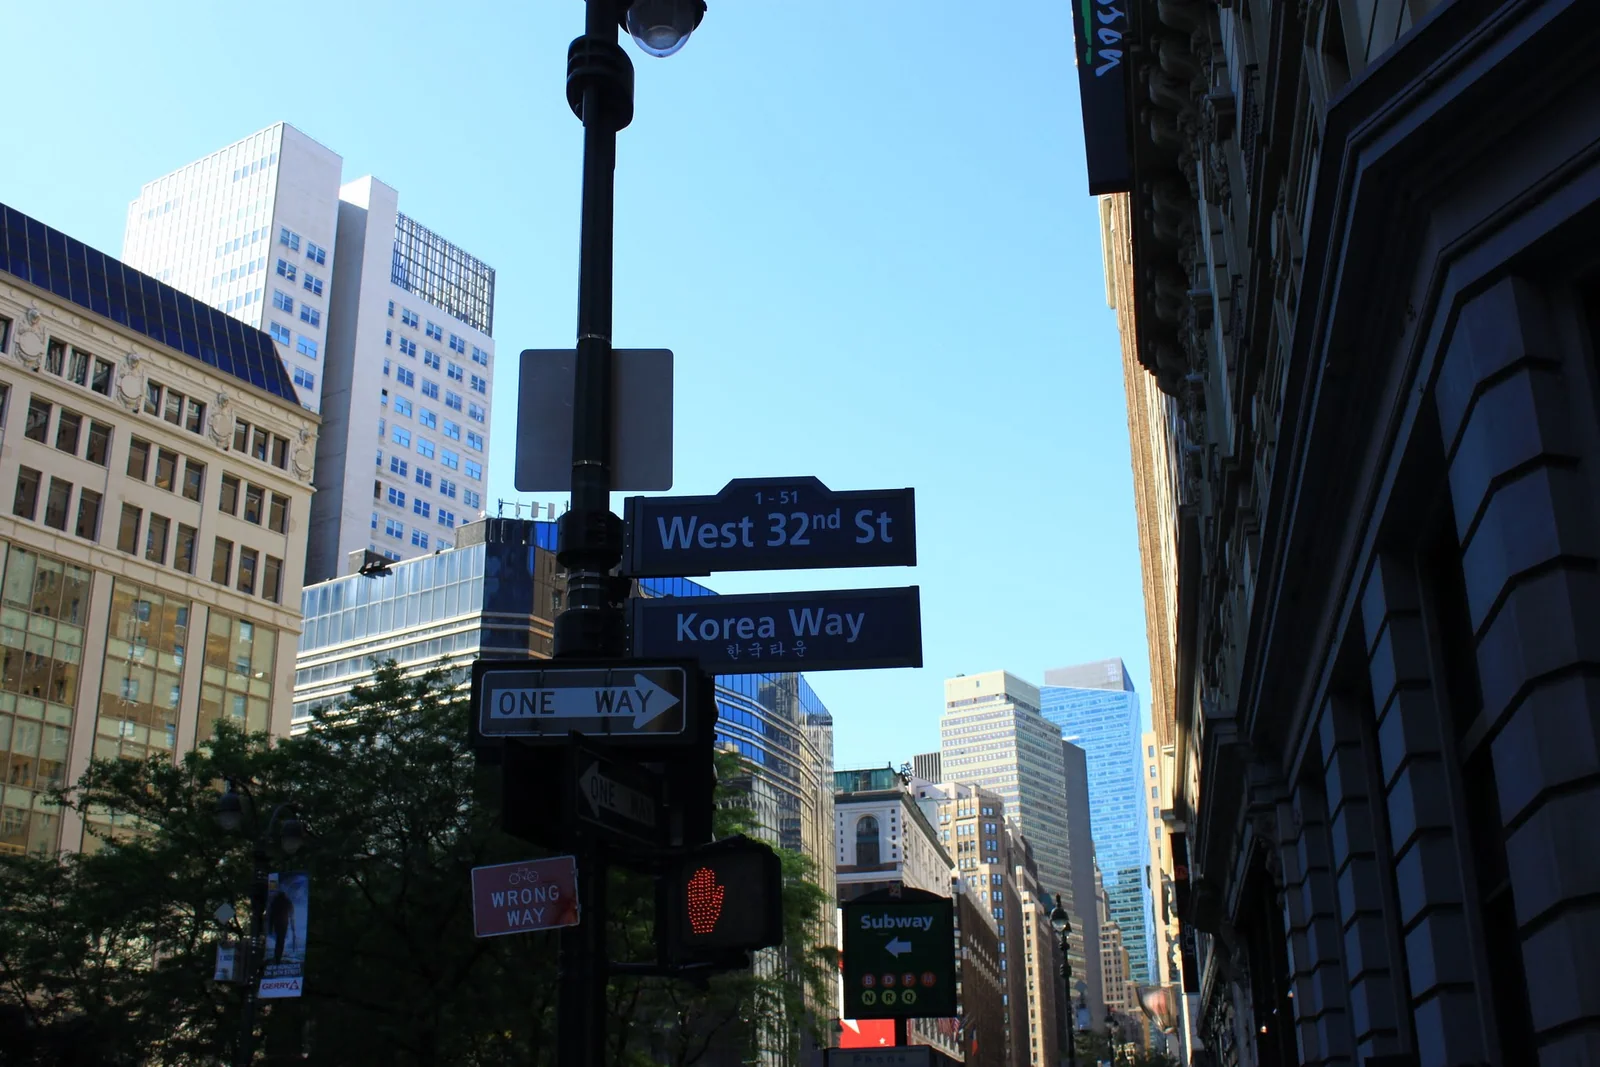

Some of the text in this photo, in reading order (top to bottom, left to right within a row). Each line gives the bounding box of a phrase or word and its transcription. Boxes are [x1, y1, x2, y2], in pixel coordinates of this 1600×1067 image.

[1095, 0, 1125, 77] son
[656, 508, 893, 550] West 32nd St
[676, 607, 865, 643] Korea Way
[499, 689, 654, 715] ONE WAY
[591, 775, 616, 808] ONE
[491, 884, 560, 909] WRONG
[507, 907, 545, 927] WAY
[860, 912, 934, 932] Subway
